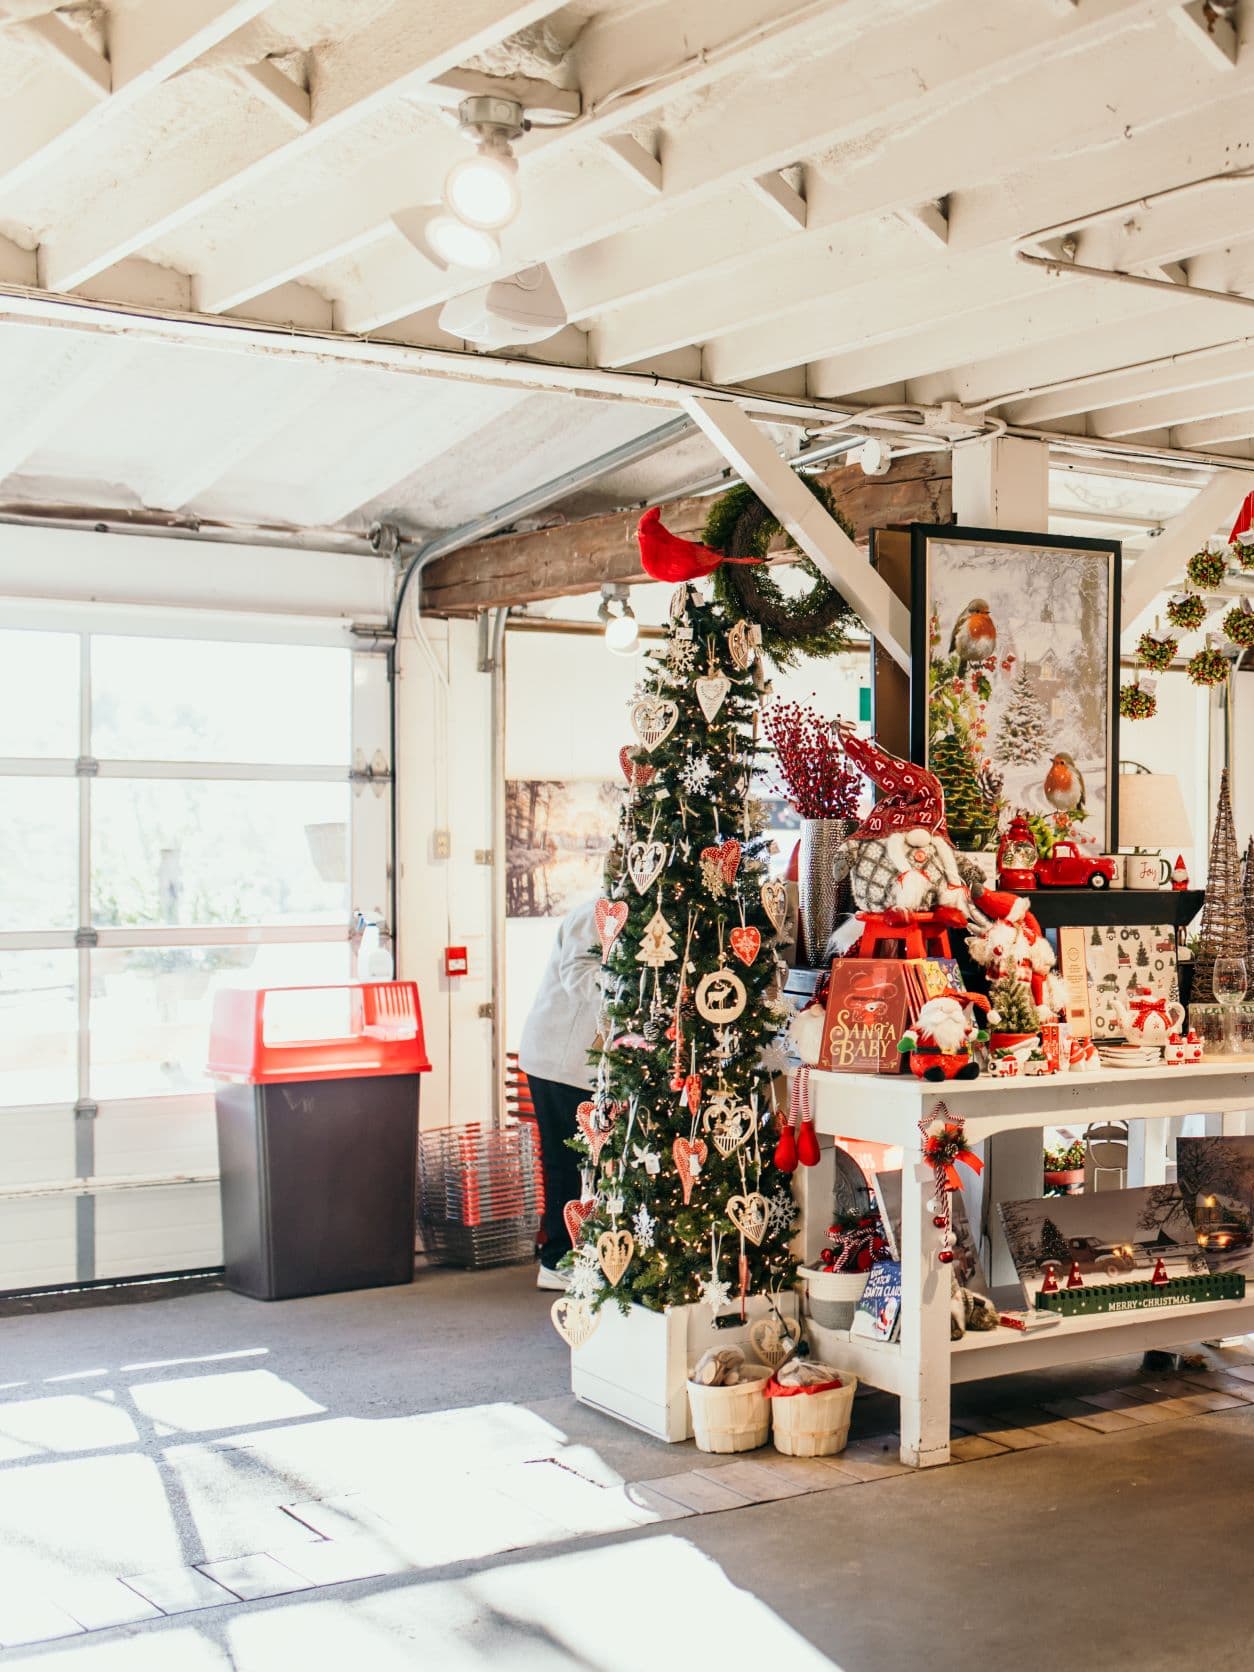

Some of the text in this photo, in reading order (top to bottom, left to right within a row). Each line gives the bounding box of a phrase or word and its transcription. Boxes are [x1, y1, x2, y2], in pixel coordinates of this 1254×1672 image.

[874, 760, 886, 771] 4
[882, 777, 895, 790] 5
[869, 818, 882, 831] 20
[918, 812, 932, 824] 22
[830, 1040, 891, 1065] BABY
[1108, 1294, 1191, 1312] MERRY CHRISTMAS
